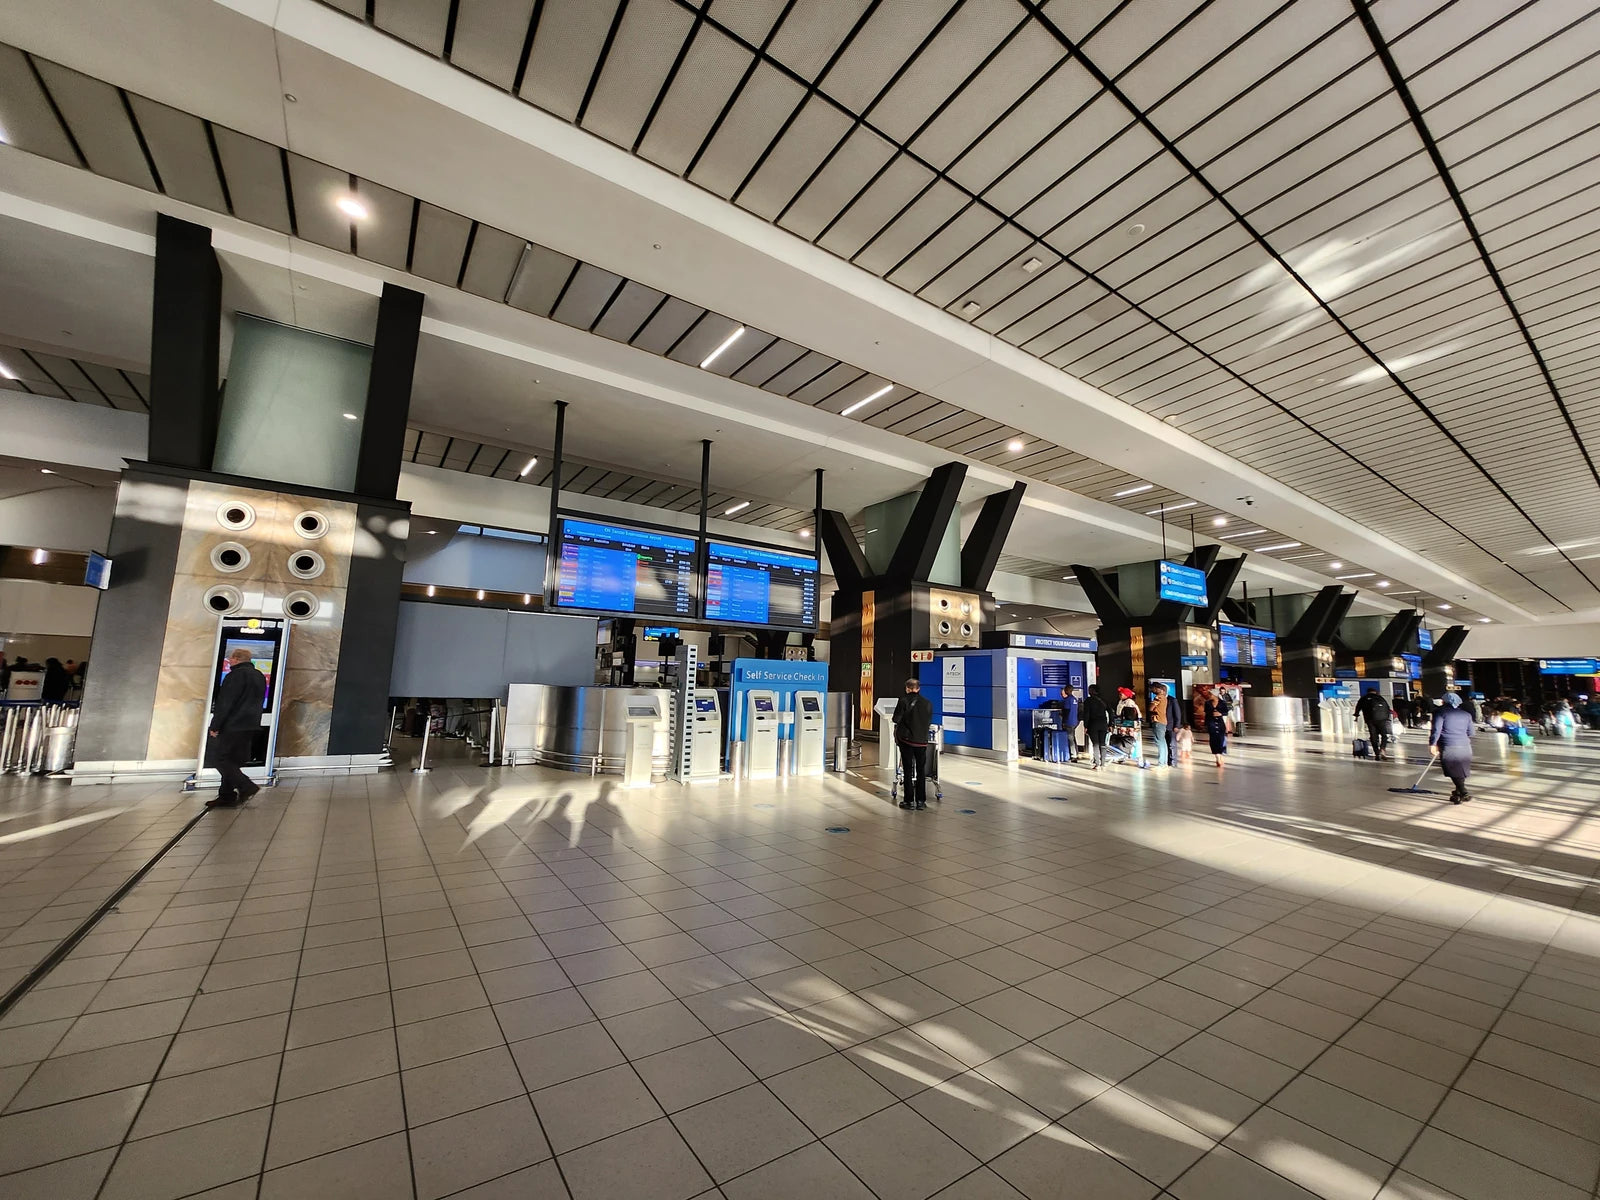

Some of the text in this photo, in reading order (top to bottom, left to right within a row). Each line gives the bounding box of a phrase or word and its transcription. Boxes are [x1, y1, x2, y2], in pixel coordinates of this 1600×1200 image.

[746, 670, 825, 681] Self Service Check In
